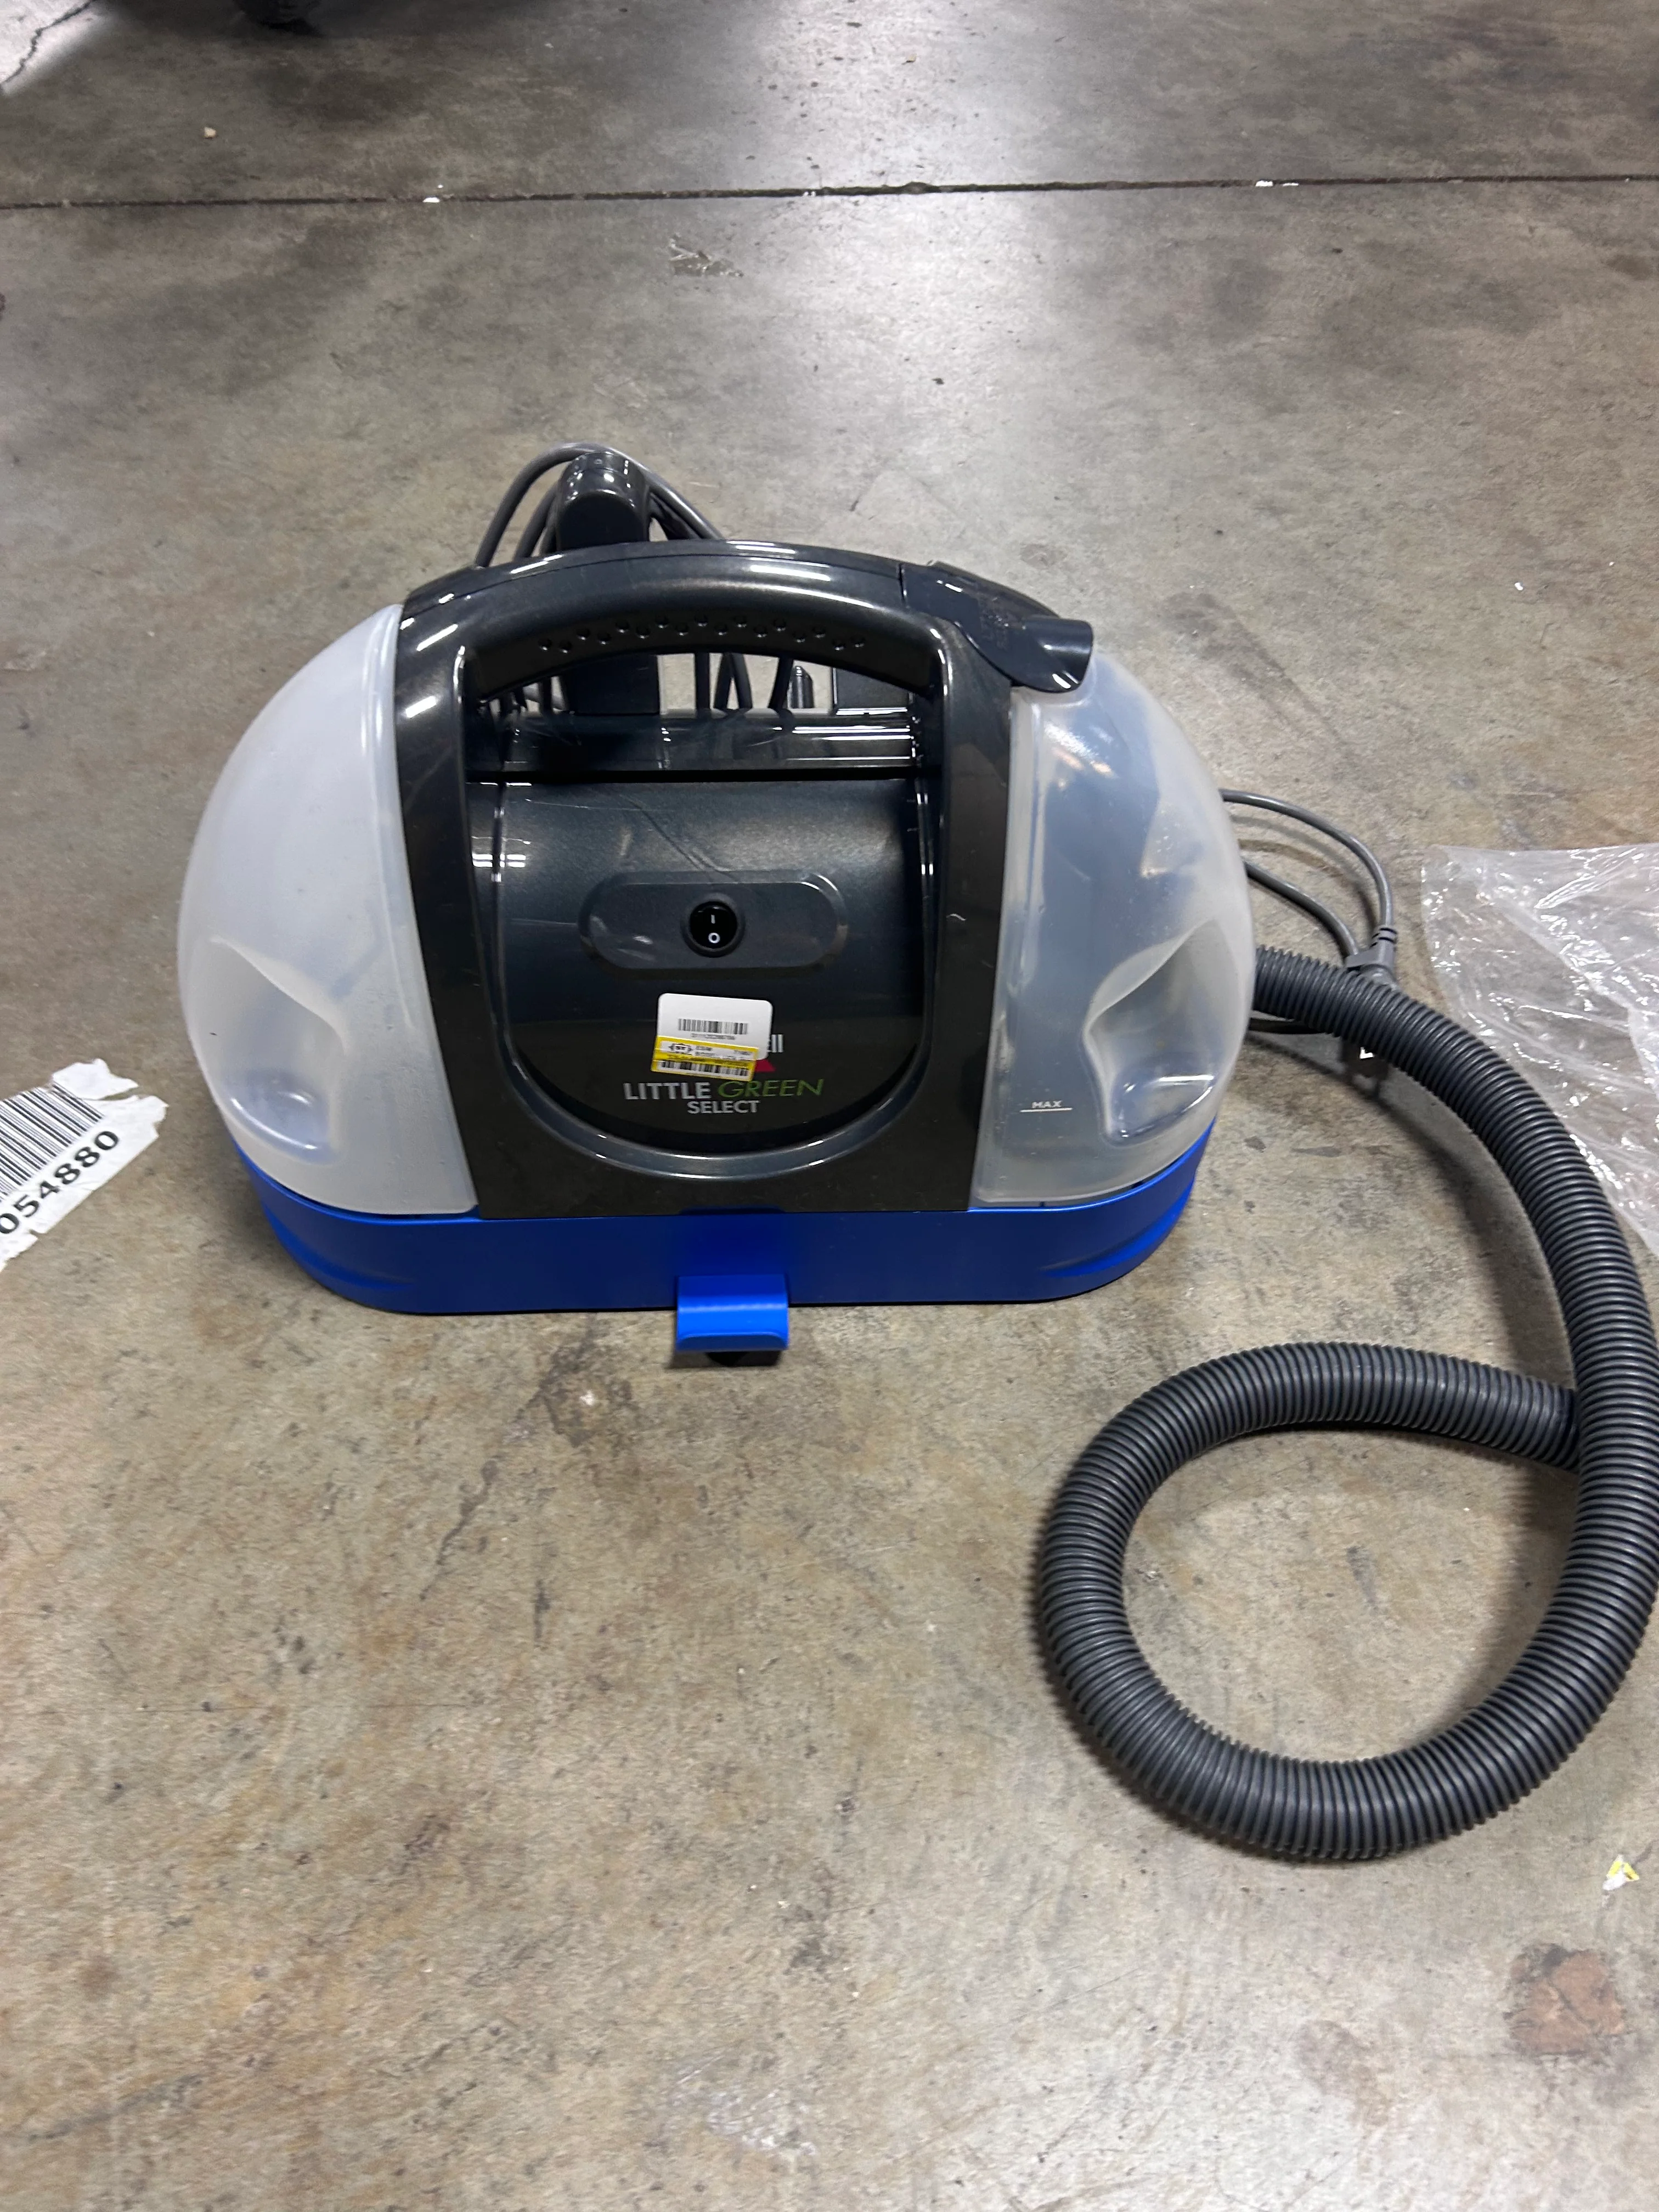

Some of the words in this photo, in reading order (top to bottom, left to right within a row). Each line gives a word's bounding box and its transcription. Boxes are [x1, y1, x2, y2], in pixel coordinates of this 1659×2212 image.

[623, 1082, 712, 1100] LITTLE
[717, 1079, 825, 1098] GREEN
[687, 1100, 760, 1114] SELECT
[1031, 1100, 1063, 1109] MAX
[0, 1130, 119, 1234] 054880
